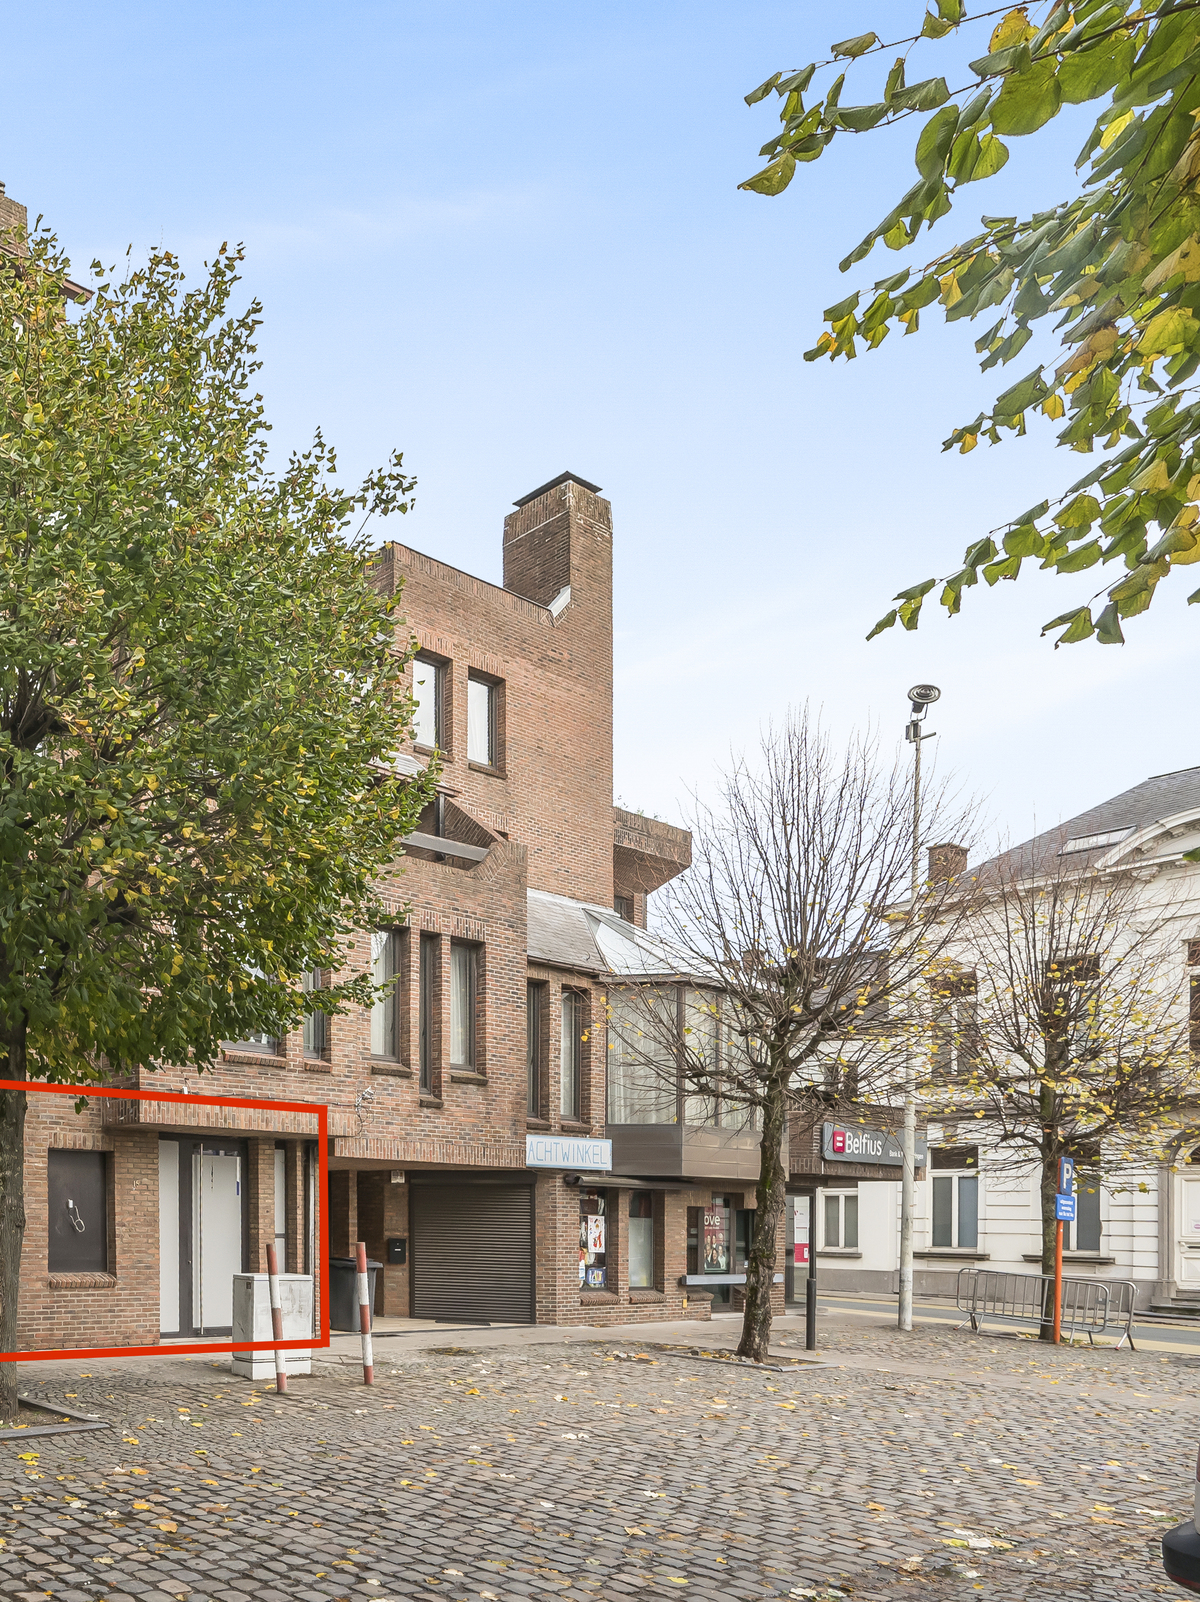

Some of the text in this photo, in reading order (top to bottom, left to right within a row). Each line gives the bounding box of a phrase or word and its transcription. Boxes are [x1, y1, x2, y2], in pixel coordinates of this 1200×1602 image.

[845, 1131, 882, 1156] Belfius
[1063, 1163, 1072, 1189] P
[704, 1215, 720, 1226] ove
